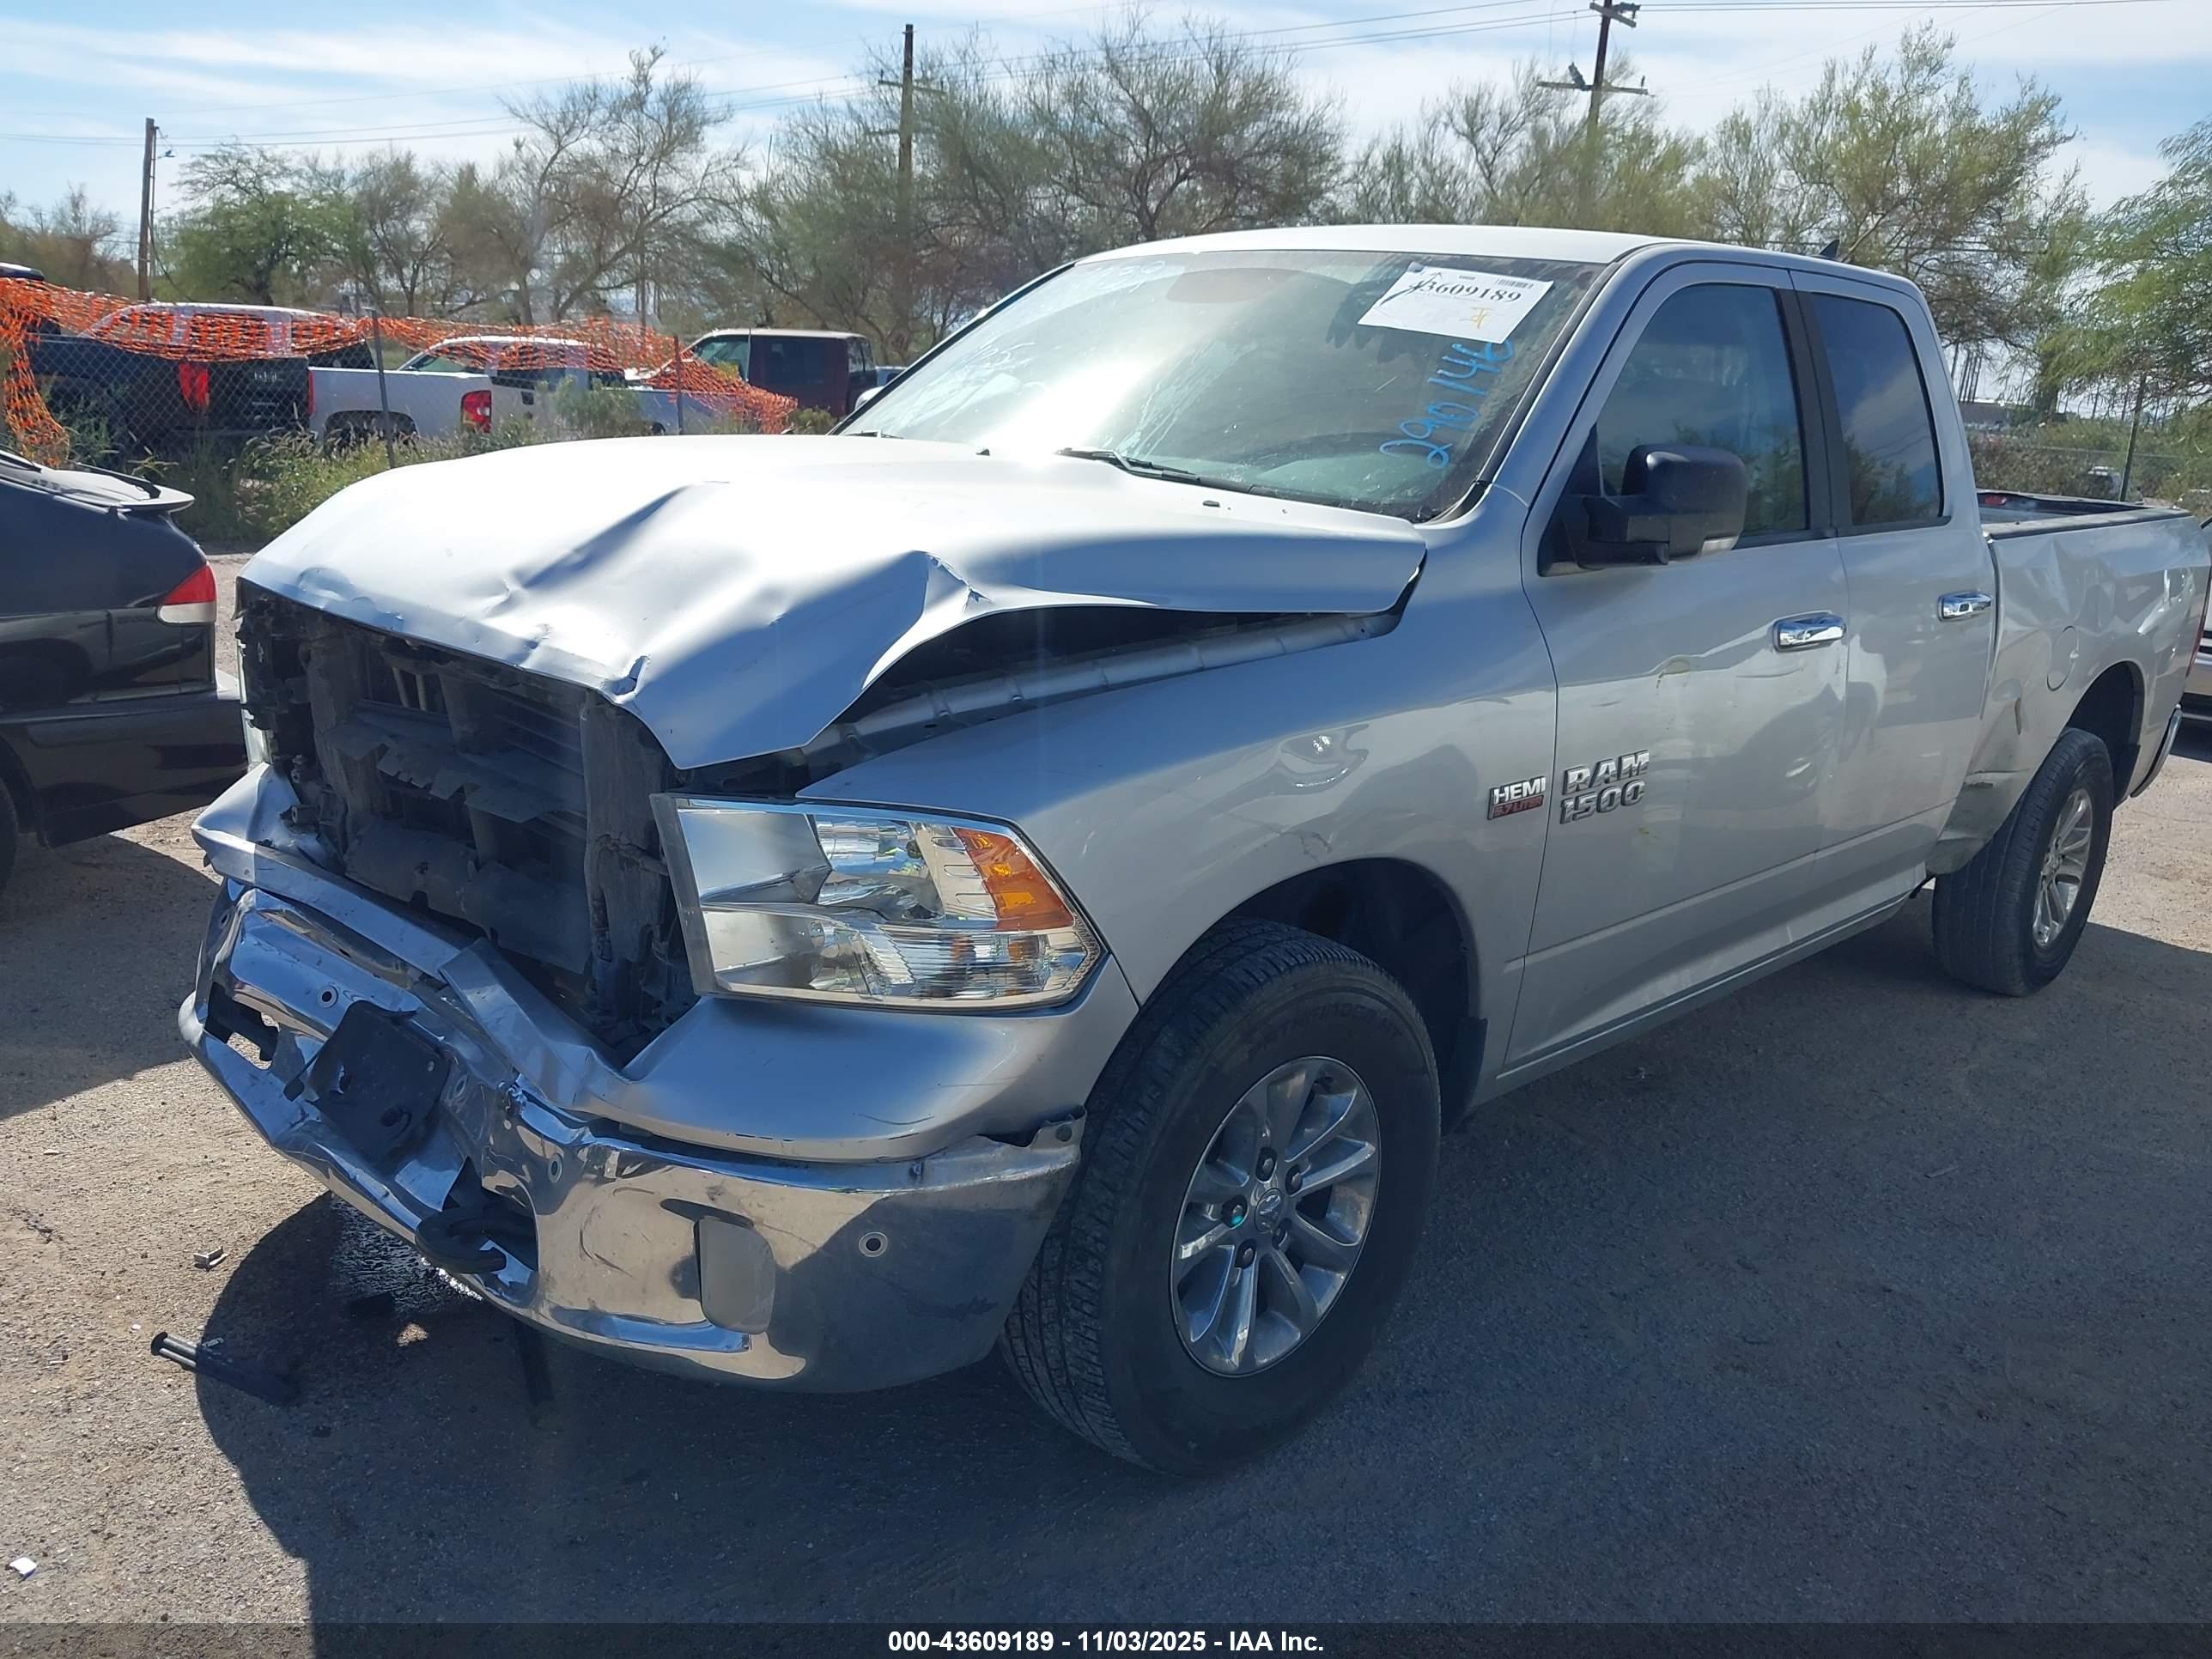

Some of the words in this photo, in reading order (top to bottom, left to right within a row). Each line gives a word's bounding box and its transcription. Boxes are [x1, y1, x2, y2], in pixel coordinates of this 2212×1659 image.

[1492, 777, 1547, 805] HEMI
[1563, 750, 1649, 795] RAM
[1560, 780, 1644, 824] 1500
